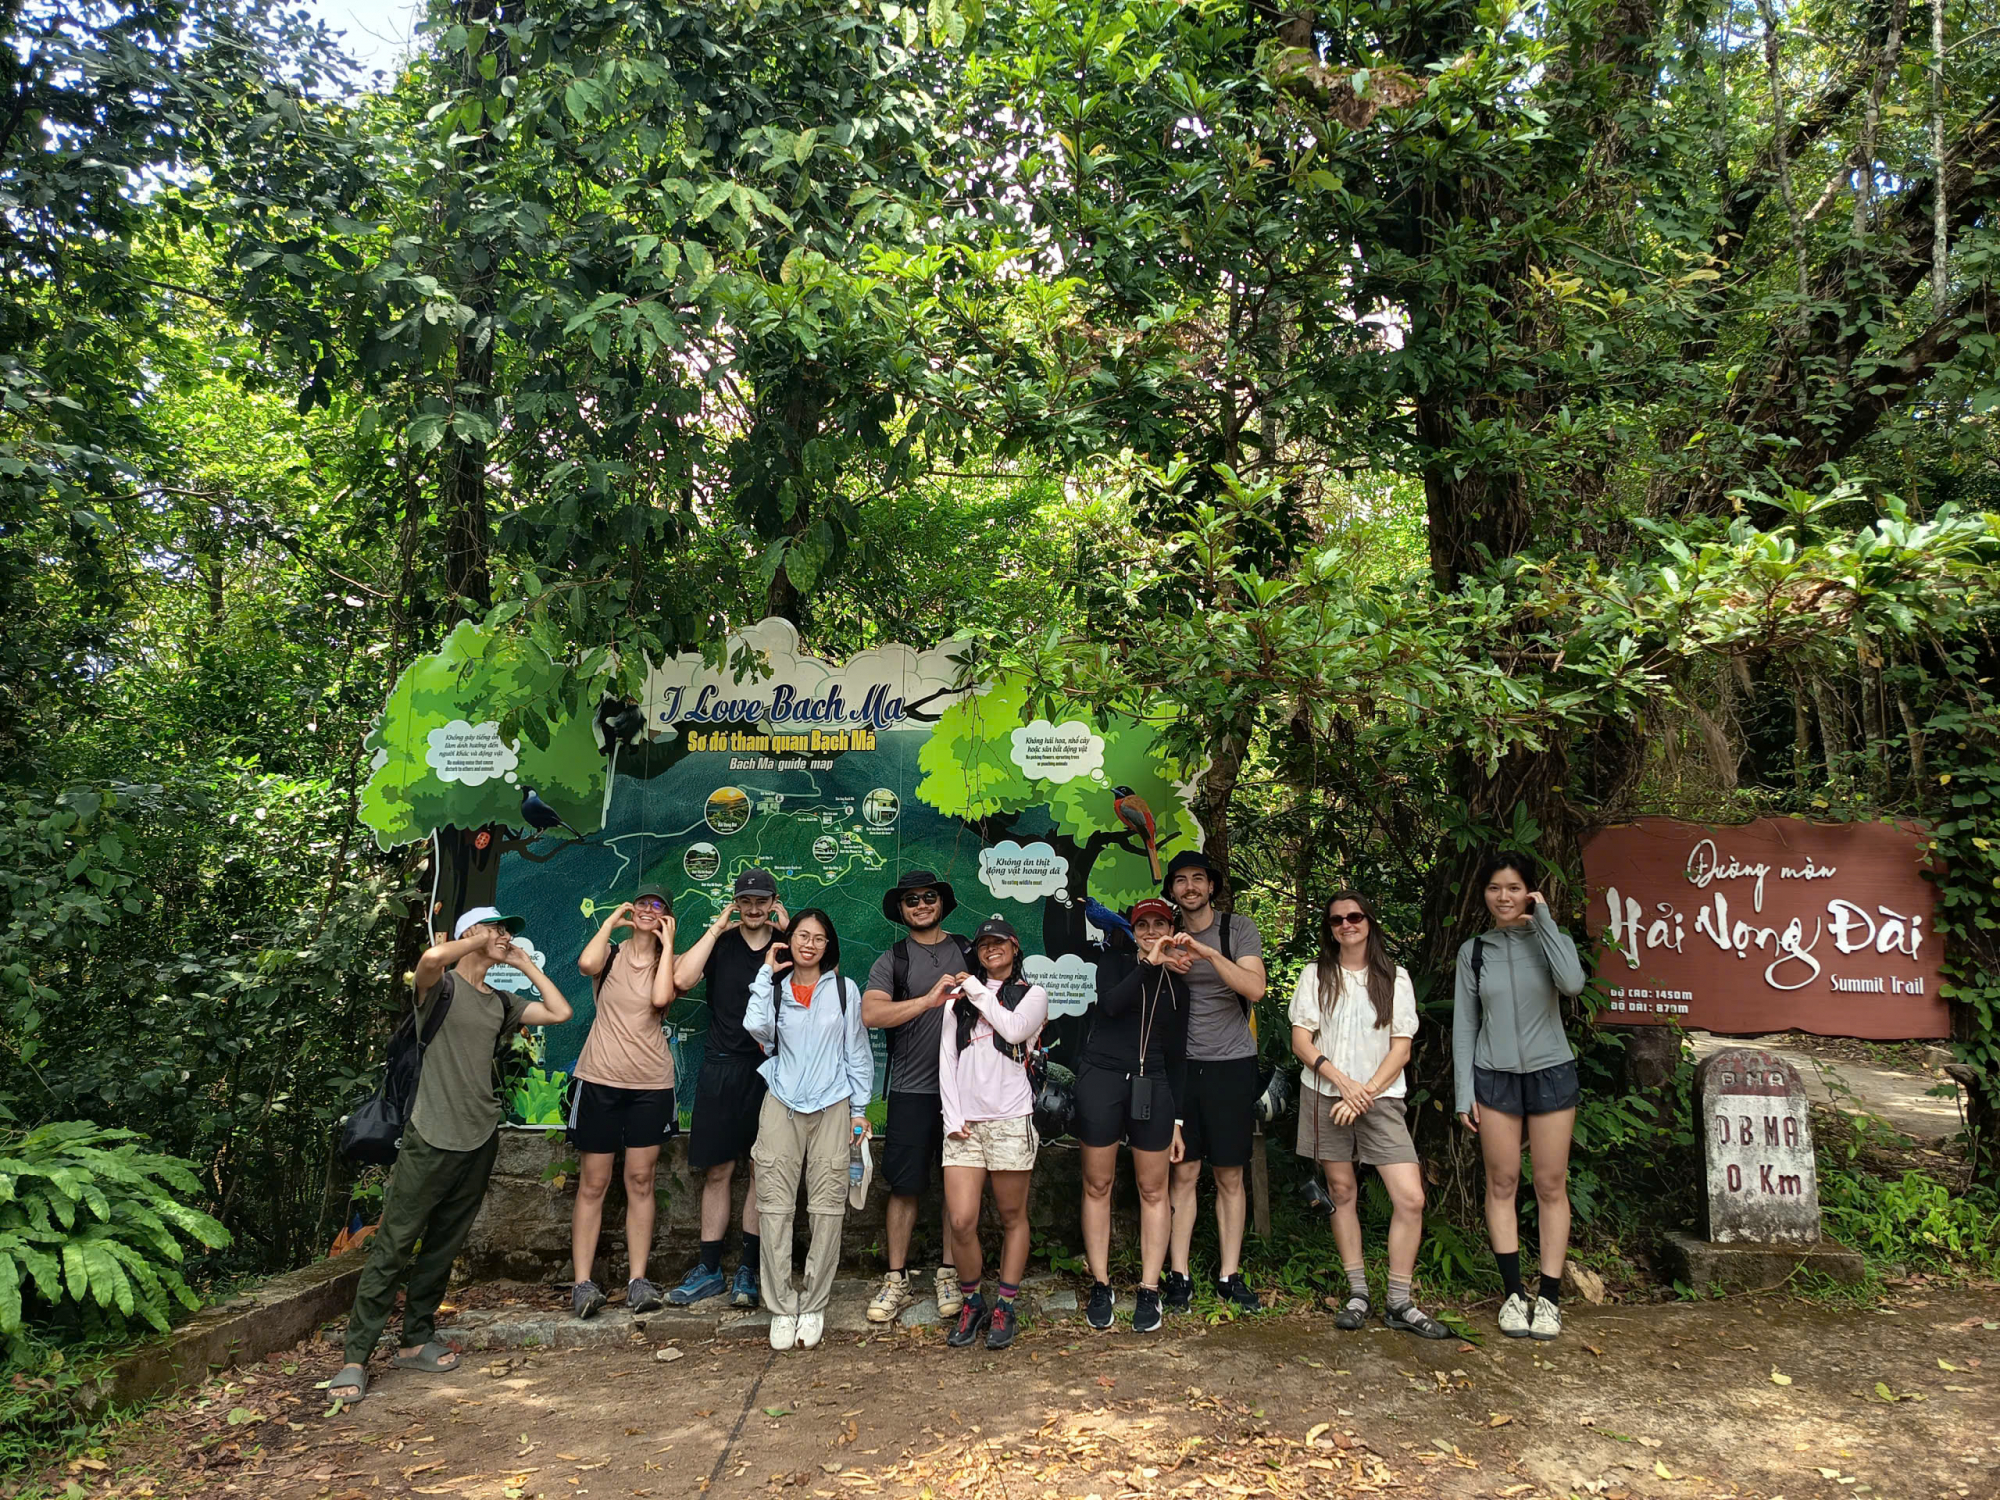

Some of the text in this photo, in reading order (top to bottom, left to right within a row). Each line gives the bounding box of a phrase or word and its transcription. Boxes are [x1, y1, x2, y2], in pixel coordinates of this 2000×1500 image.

[660, 683, 907, 730] I Love Bach Ma
[688, 730, 876, 754] Sơ đồ tham quan Bạch Mã
[1026, 737, 1043, 745] Không
[729, 758, 834, 773] Bach Ma guide map
[986, 866, 1060, 876] động vật hoang dã
[996, 858, 1050, 867] Không ăn thịt
[1686, 838, 1836, 913] Đường mòn
[1606, 886, 1924, 991] Hải Vọng Đài
[1025, 972, 1038, 980] hông
[1830, 973, 1924, 995] Summit Trail
[1628, 989, 1652, 998] CAO:
[1727, 1163, 1802, 1195] 0 Km
